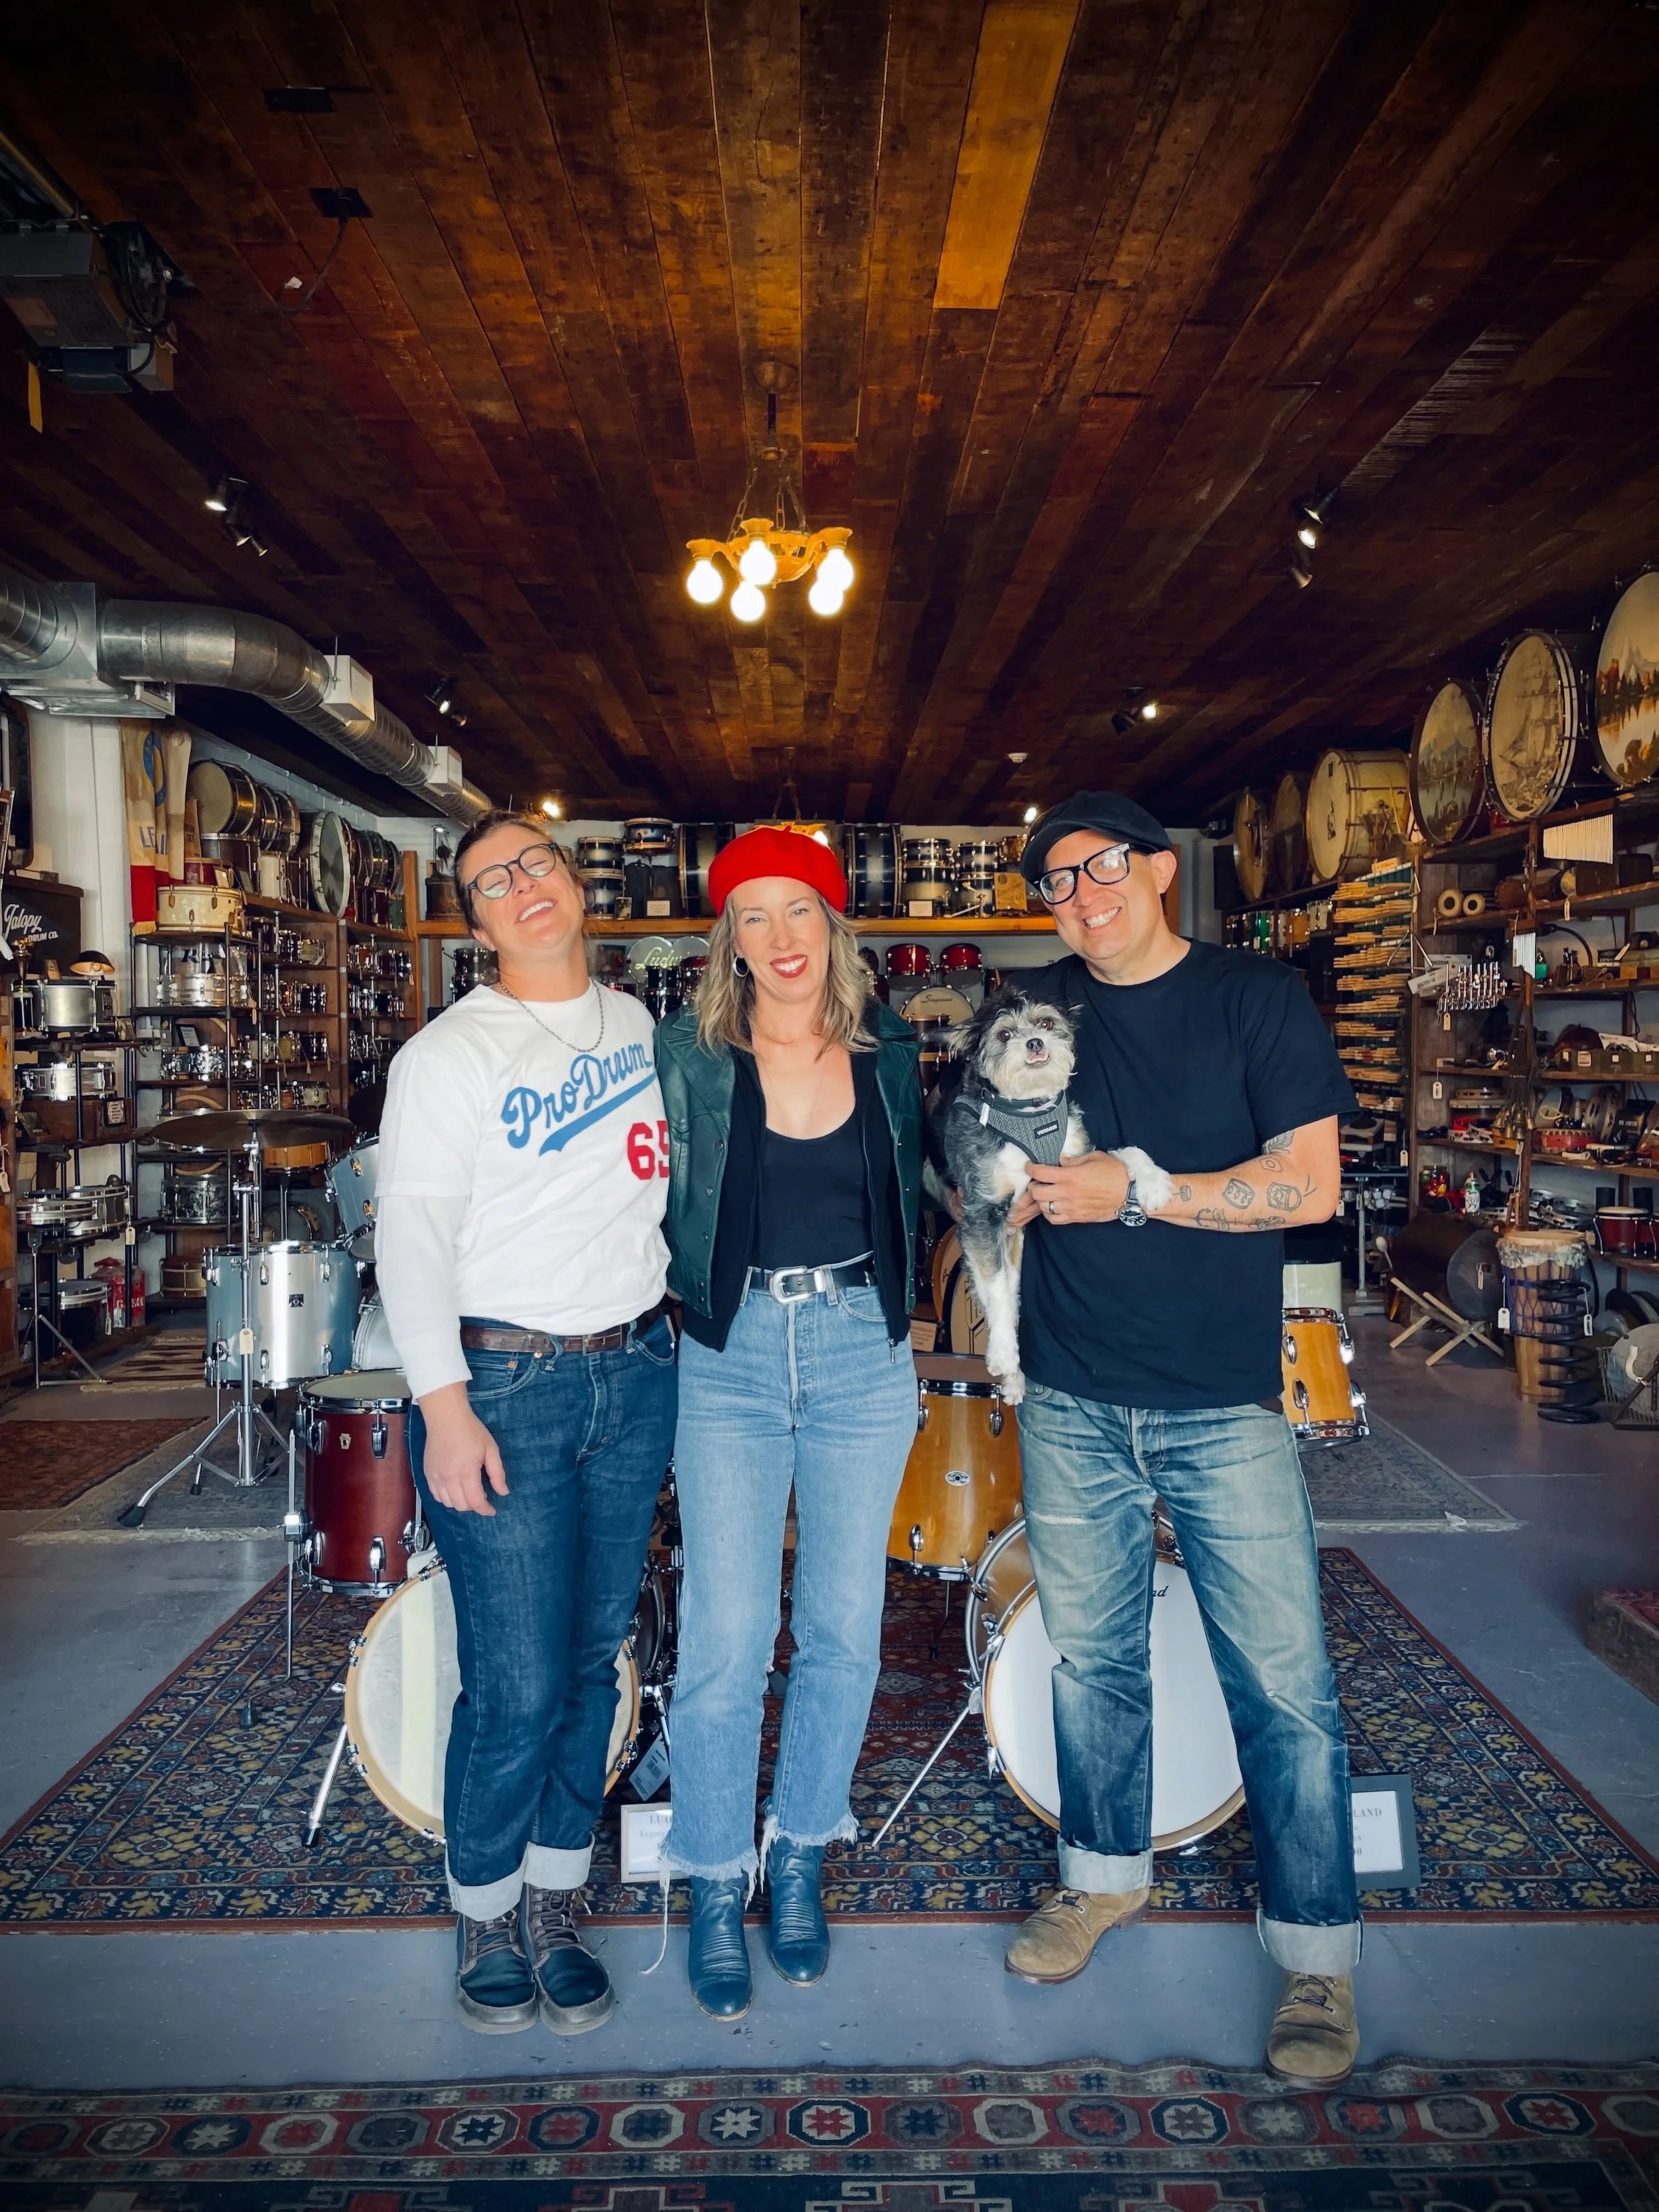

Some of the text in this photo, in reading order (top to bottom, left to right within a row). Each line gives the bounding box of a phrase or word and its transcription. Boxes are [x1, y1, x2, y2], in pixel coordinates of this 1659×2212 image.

[4, 904, 42, 941] Jalopy
[28, 930, 59, 942] DRUM CO.
